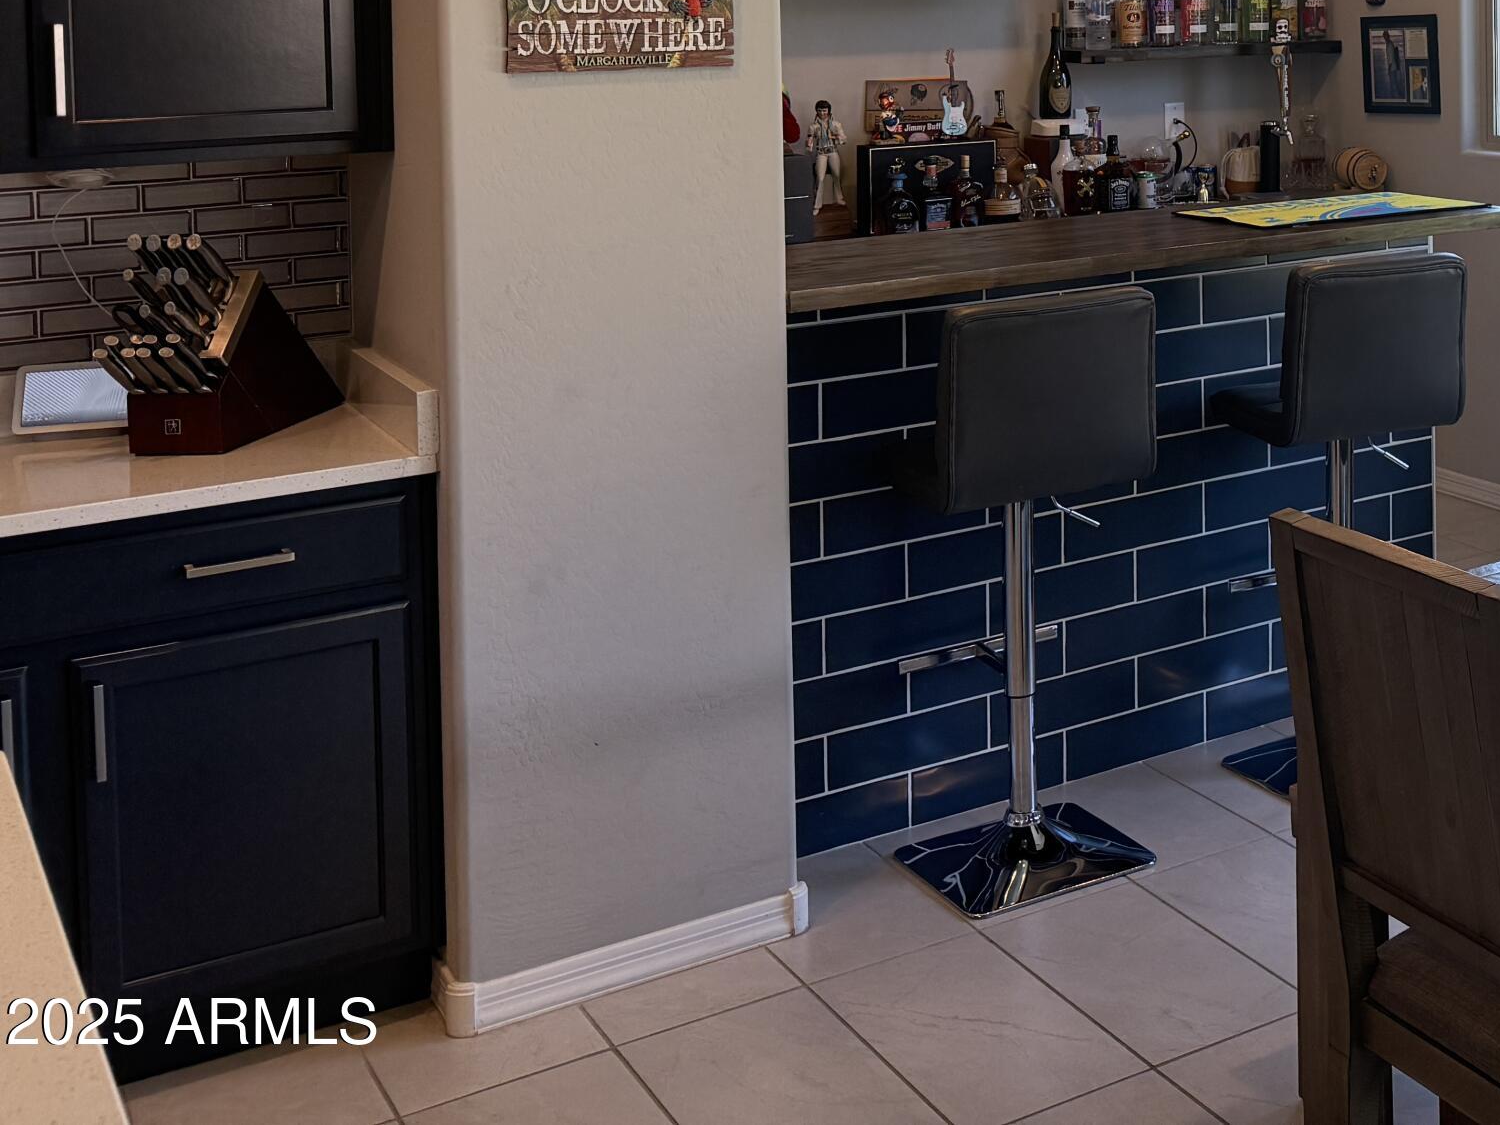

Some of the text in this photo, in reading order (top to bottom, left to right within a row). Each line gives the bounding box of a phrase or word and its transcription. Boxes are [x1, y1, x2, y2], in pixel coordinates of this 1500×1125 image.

[517, 17, 726, 56] SOMEWHERE
[576, 53, 673, 67] MARGARITAVILLE
[904, 123, 926, 132] Jimmy
